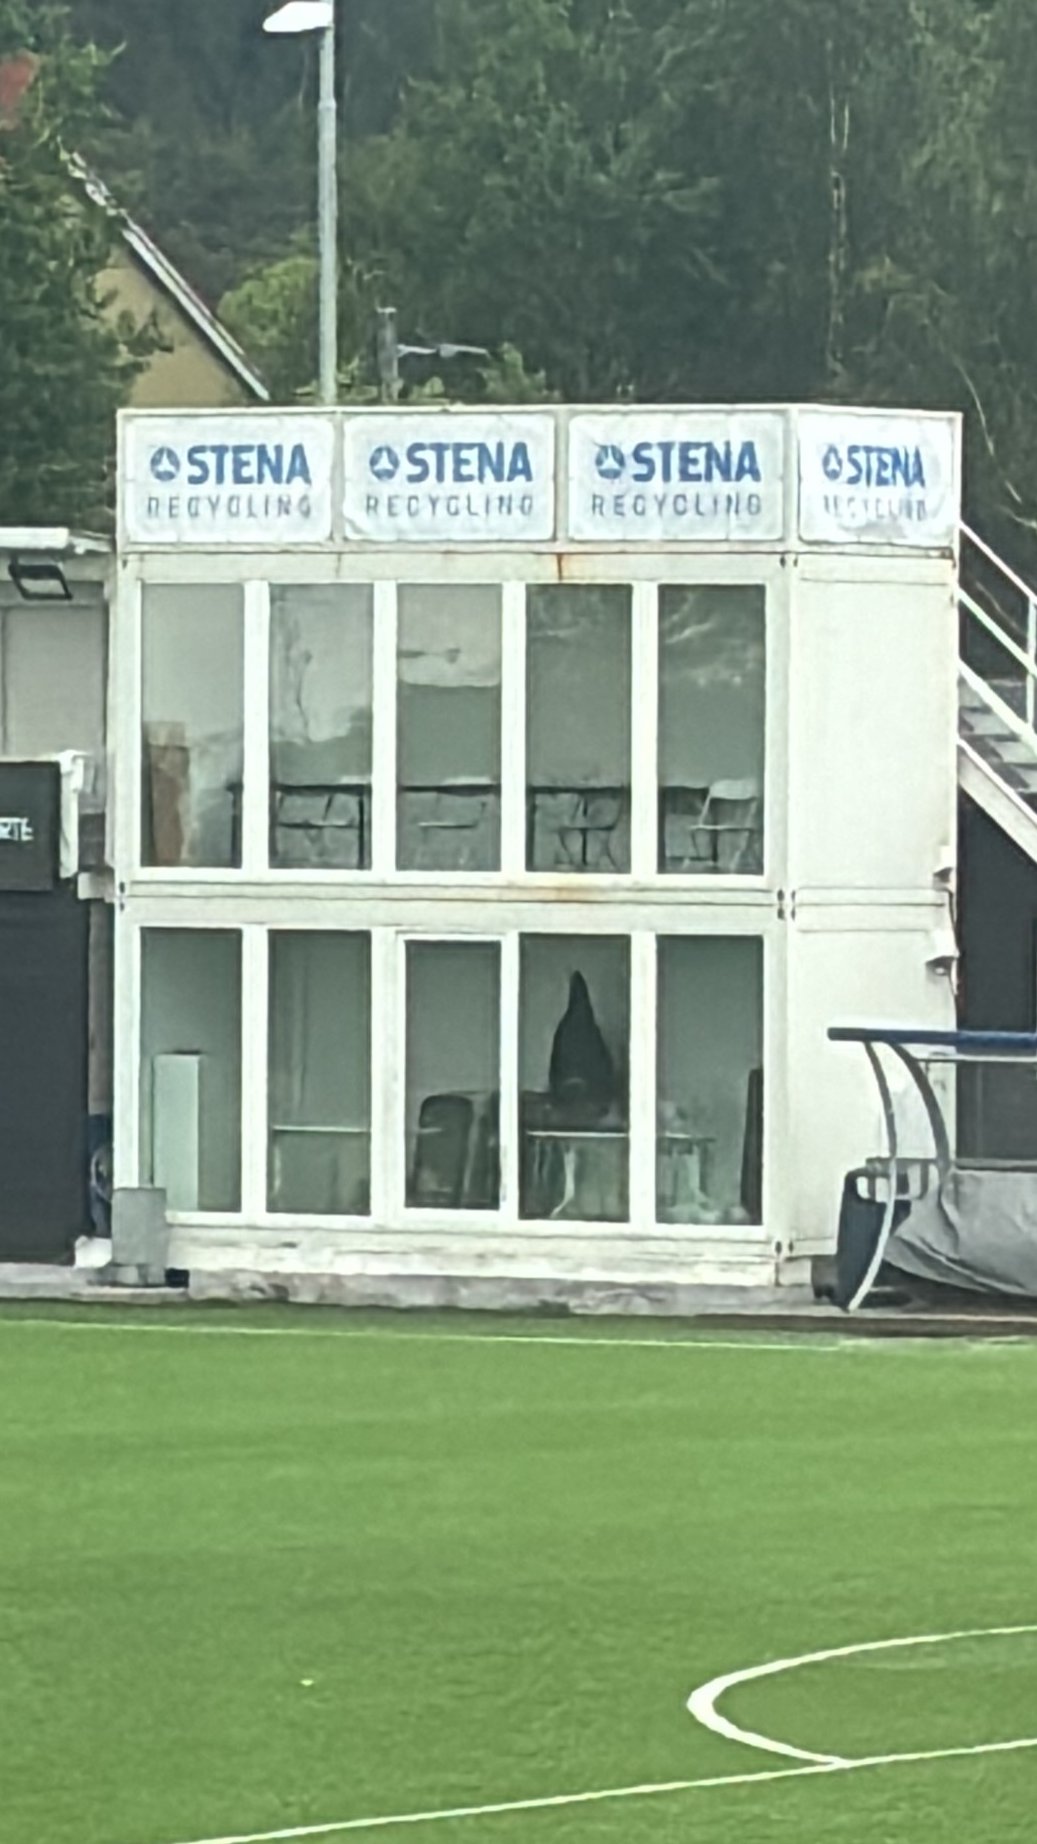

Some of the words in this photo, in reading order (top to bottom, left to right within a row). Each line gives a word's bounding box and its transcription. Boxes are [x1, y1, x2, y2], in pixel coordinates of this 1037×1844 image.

[187, 444, 311, 485] STENA
[406, 441, 533, 484] STENA
[632, 441, 762, 483] STENA
[846, 445, 926, 488] STENA
[147, 492, 312, 520] RECYCLING
[365, 491, 533, 518] RECYCLING
[591, 491, 762, 517] RECYCLING
